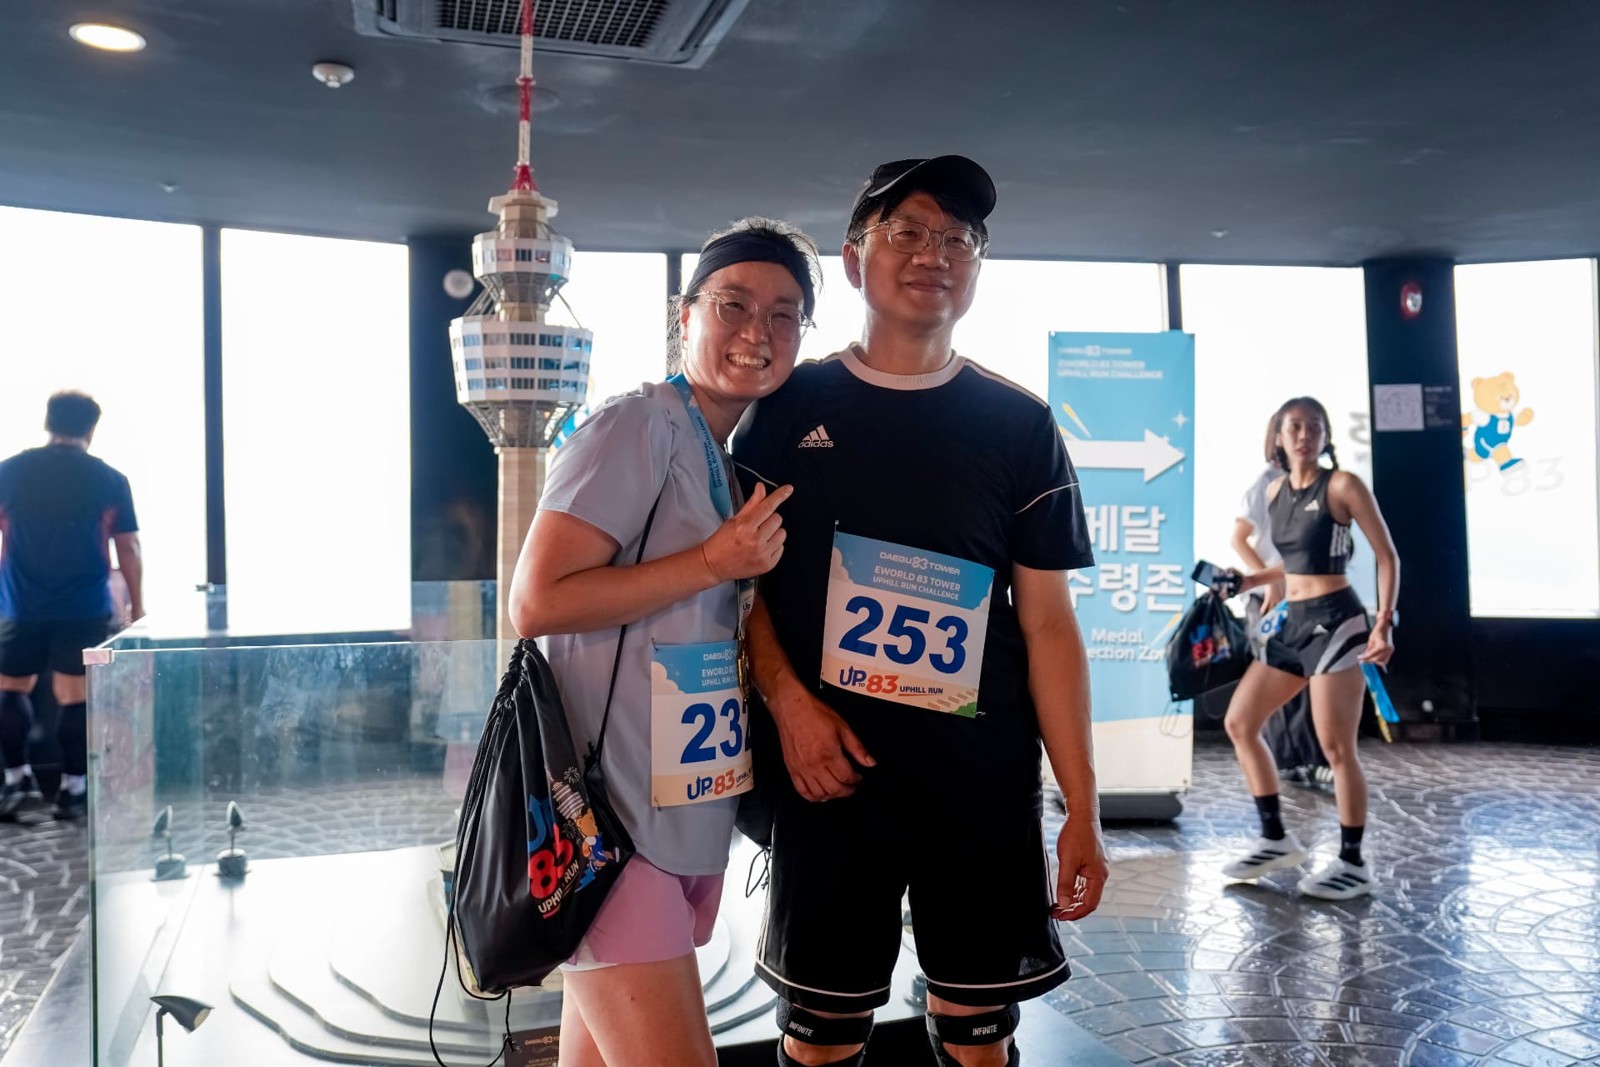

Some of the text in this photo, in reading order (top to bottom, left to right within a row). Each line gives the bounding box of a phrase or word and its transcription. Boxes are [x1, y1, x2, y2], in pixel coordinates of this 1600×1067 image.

[798, 439, 834, 448] adidas
[873, 576, 959, 600] UPHILL RUN CHALLENGE
[875, 565, 961, 592] EWORLD 83 TOWER
[838, 595, 969, 674] 253
[1091, 628, 1143, 643] Medal
[1087, 646, 1136, 660] ection
[702, 666, 728, 677] EWORLD
[839, 665, 867, 687] UP
[866, 674, 899, 694] 83
[900, 686, 926, 694] UPHILL
[928, 687, 943, 695] RUN
[702, 678, 721, 687] UPHILL
[680, 698, 752, 764] 23
[687, 776, 713, 800] UP
[714, 768, 735, 795] 83
[564, 859, 580, 883] RUN
[788, 1021, 814, 1037] INFINITE
[972, 1024, 997, 1036] INFINITE
